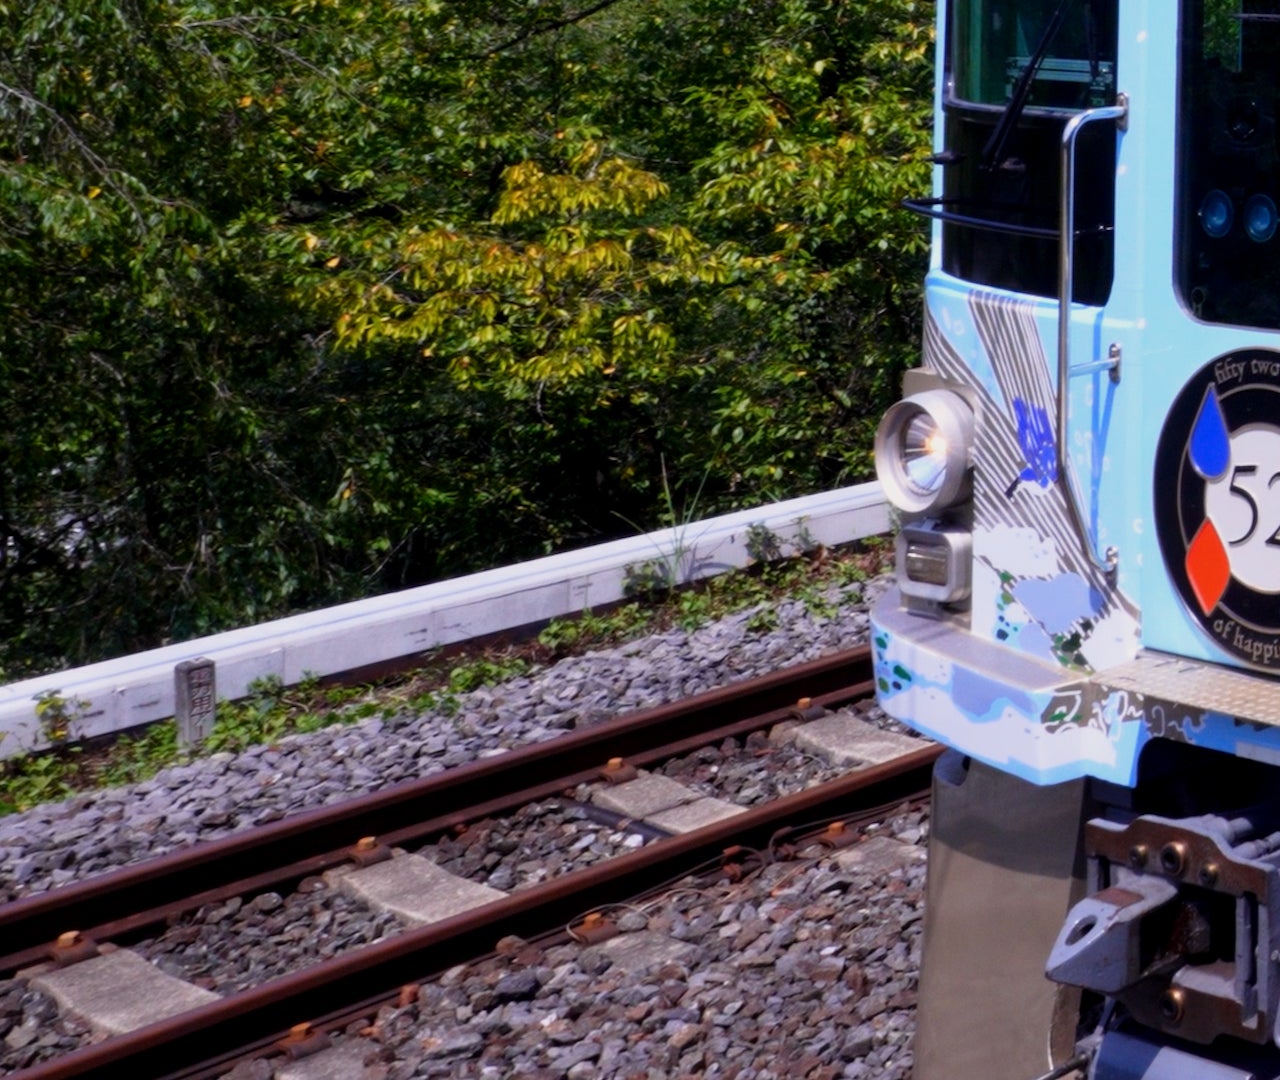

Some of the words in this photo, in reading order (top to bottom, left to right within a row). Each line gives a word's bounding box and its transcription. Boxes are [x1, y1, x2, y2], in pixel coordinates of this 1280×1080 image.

[1213, 358, 1248, 384] fifty
[1249, 358, 1280, 377] two
[1212, 618, 1234, 636] of
